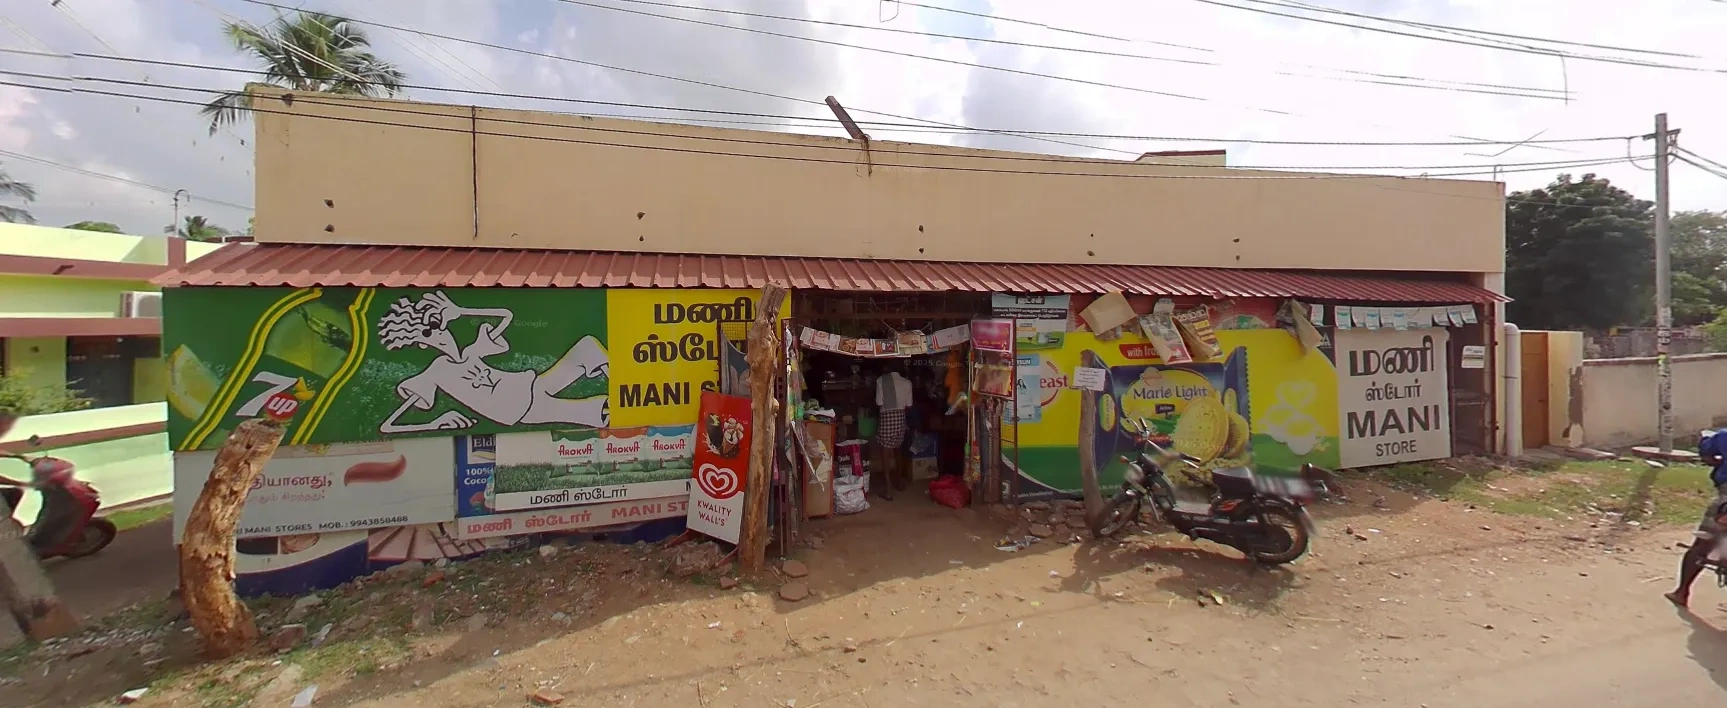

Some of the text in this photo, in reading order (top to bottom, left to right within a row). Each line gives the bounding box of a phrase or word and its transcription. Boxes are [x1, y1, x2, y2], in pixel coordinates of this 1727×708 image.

[1127, 346, 1159, 357] with Iro
[1349, 334, 1434, 376] மணி
[1040, 374, 1069, 388] east
[1365, 378, 1422, 401] ஸ்டோர்
[619, 382, 690, 408] MANI
[1133, 384, 1208, 400] Marie Light
[1347, 405, 1441, 439] MANI
[1375, 439, 1417, 457] STORE
[530, 489, 569, 505] மணி
[467, 517, 513, 534] மணி
[611, 503, 662, 519] MANI
[667, 500, 689, 513] ST
[697, 500, 732, 517] KWALITY
[275, 523, 313, 532] STORES
[698, 511, 725, 527] WALL'S
